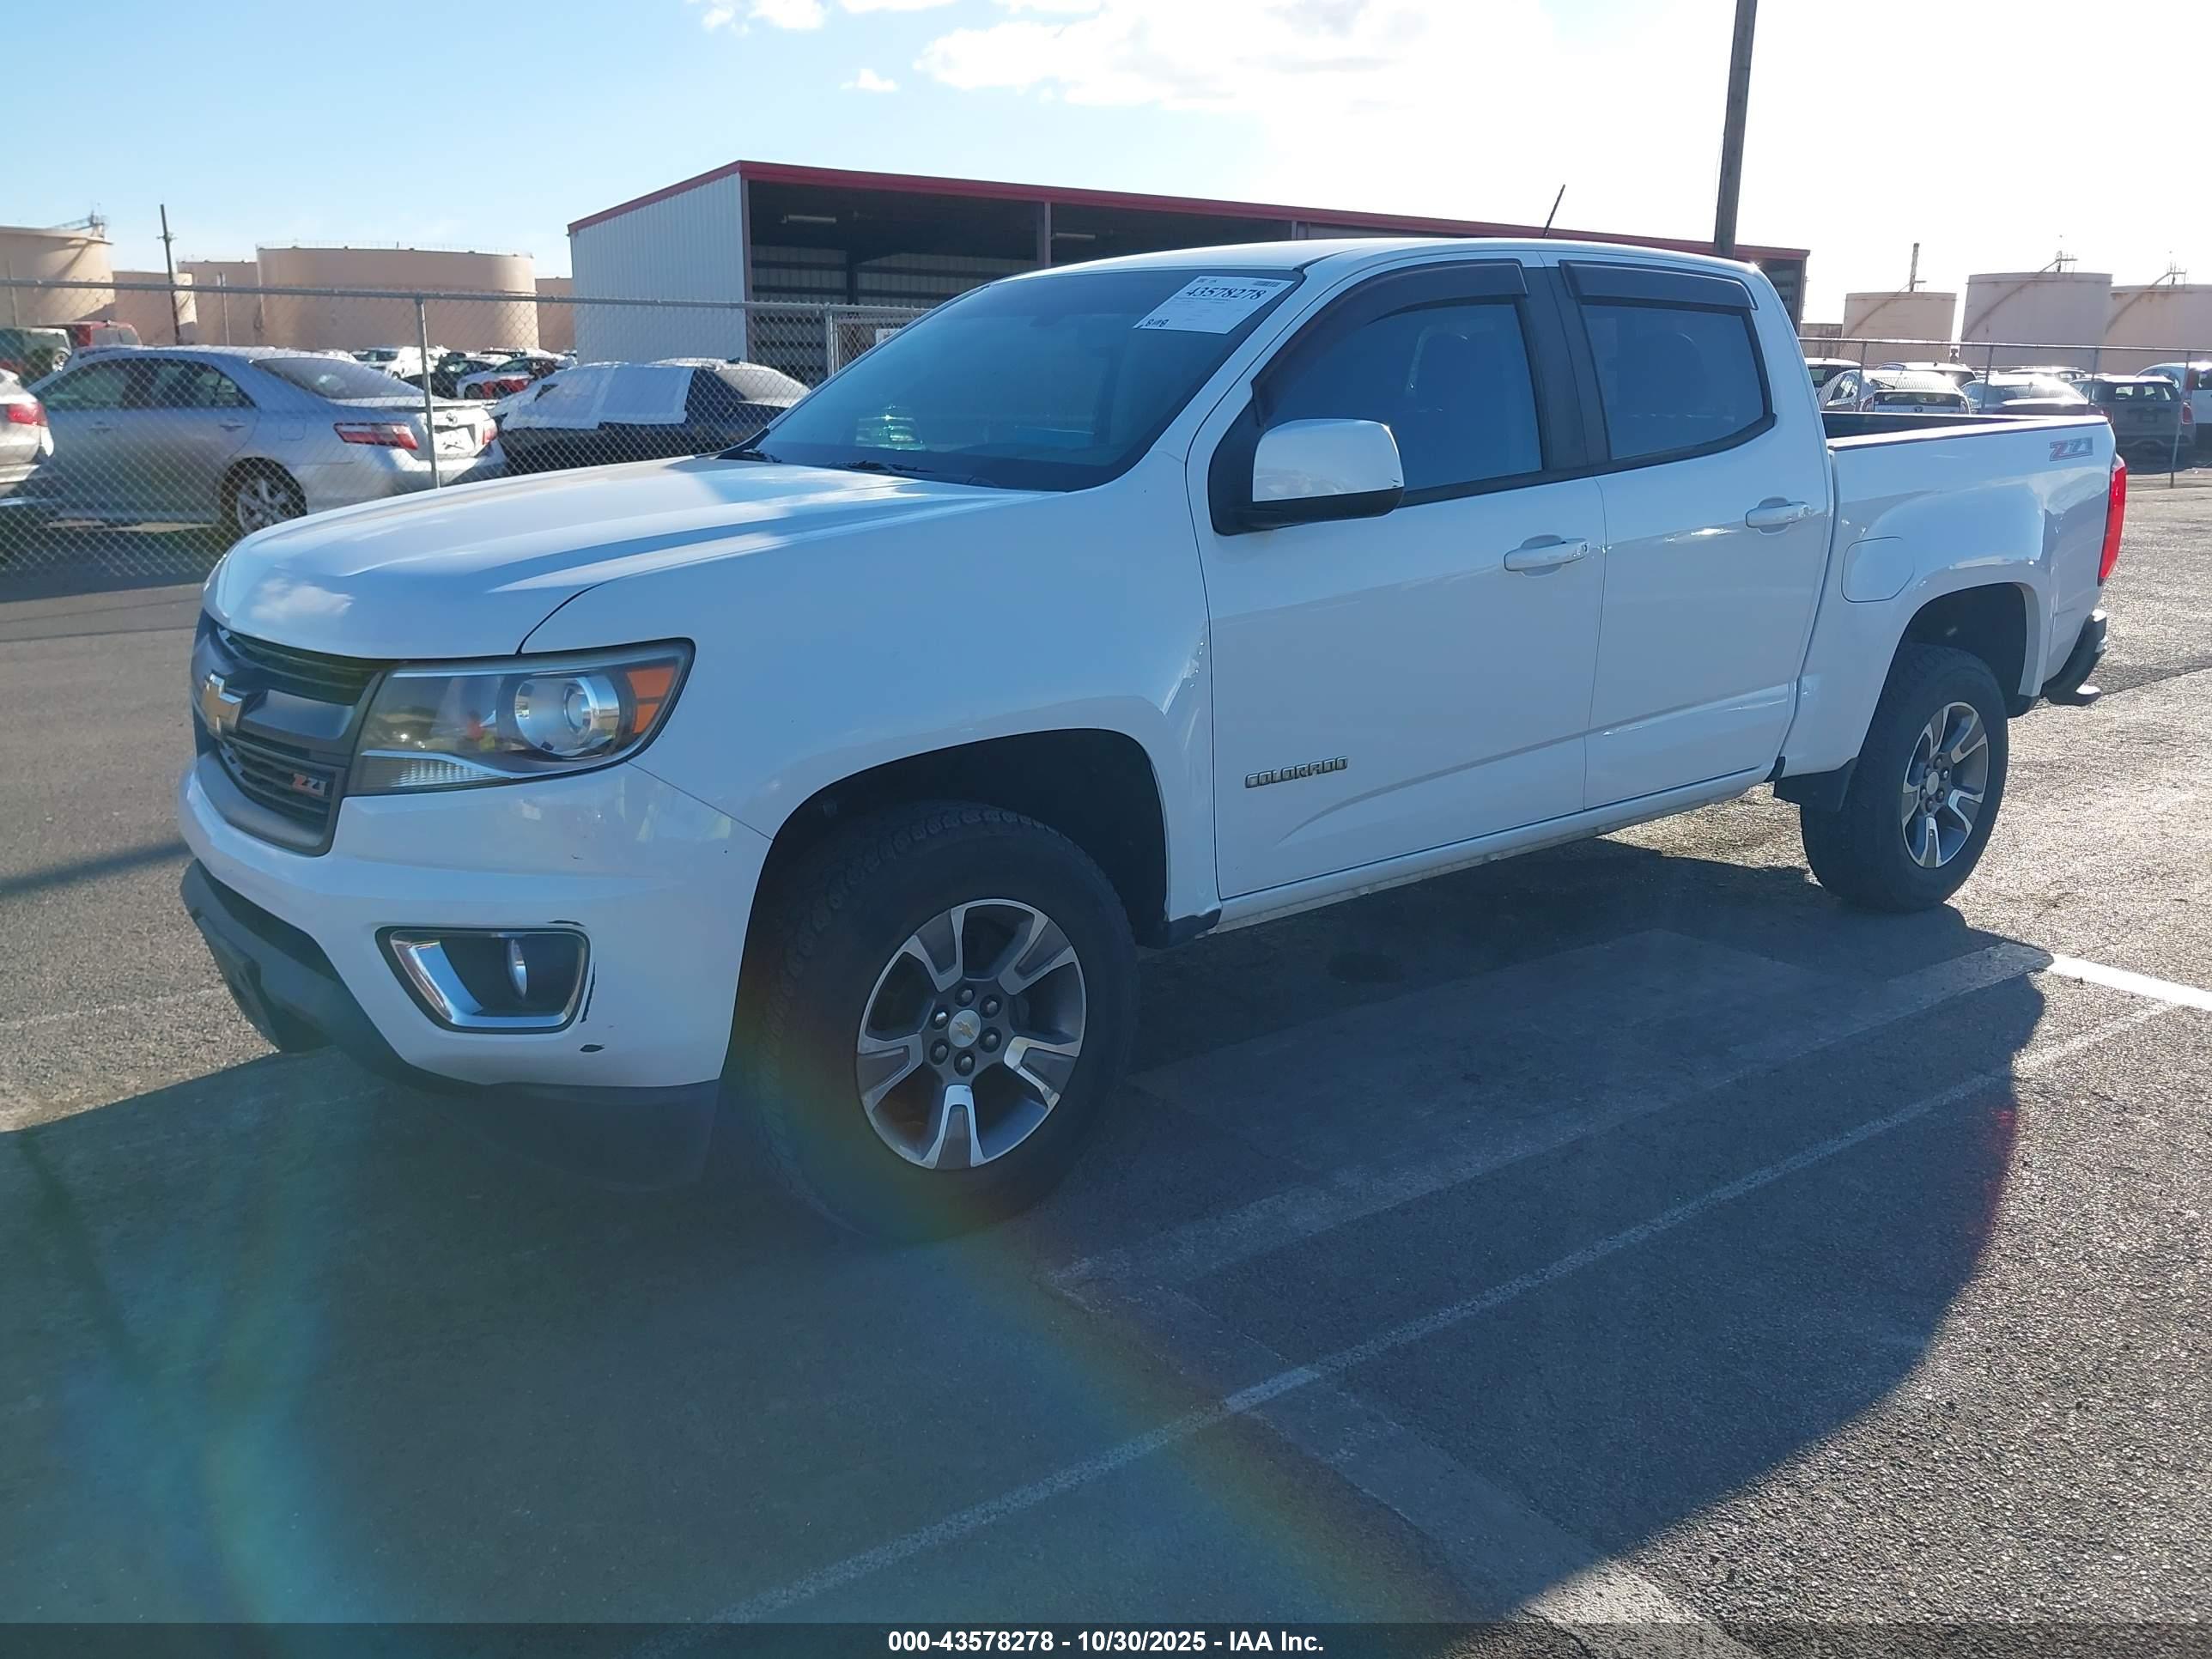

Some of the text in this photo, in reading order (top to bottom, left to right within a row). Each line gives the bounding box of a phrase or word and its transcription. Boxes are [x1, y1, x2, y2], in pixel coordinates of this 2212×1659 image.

[1187, 286, 1267, 301] 43578278
[2049, 437, 2094, 462] Z71
[1245, 756, 1348, 788] COLORADO
